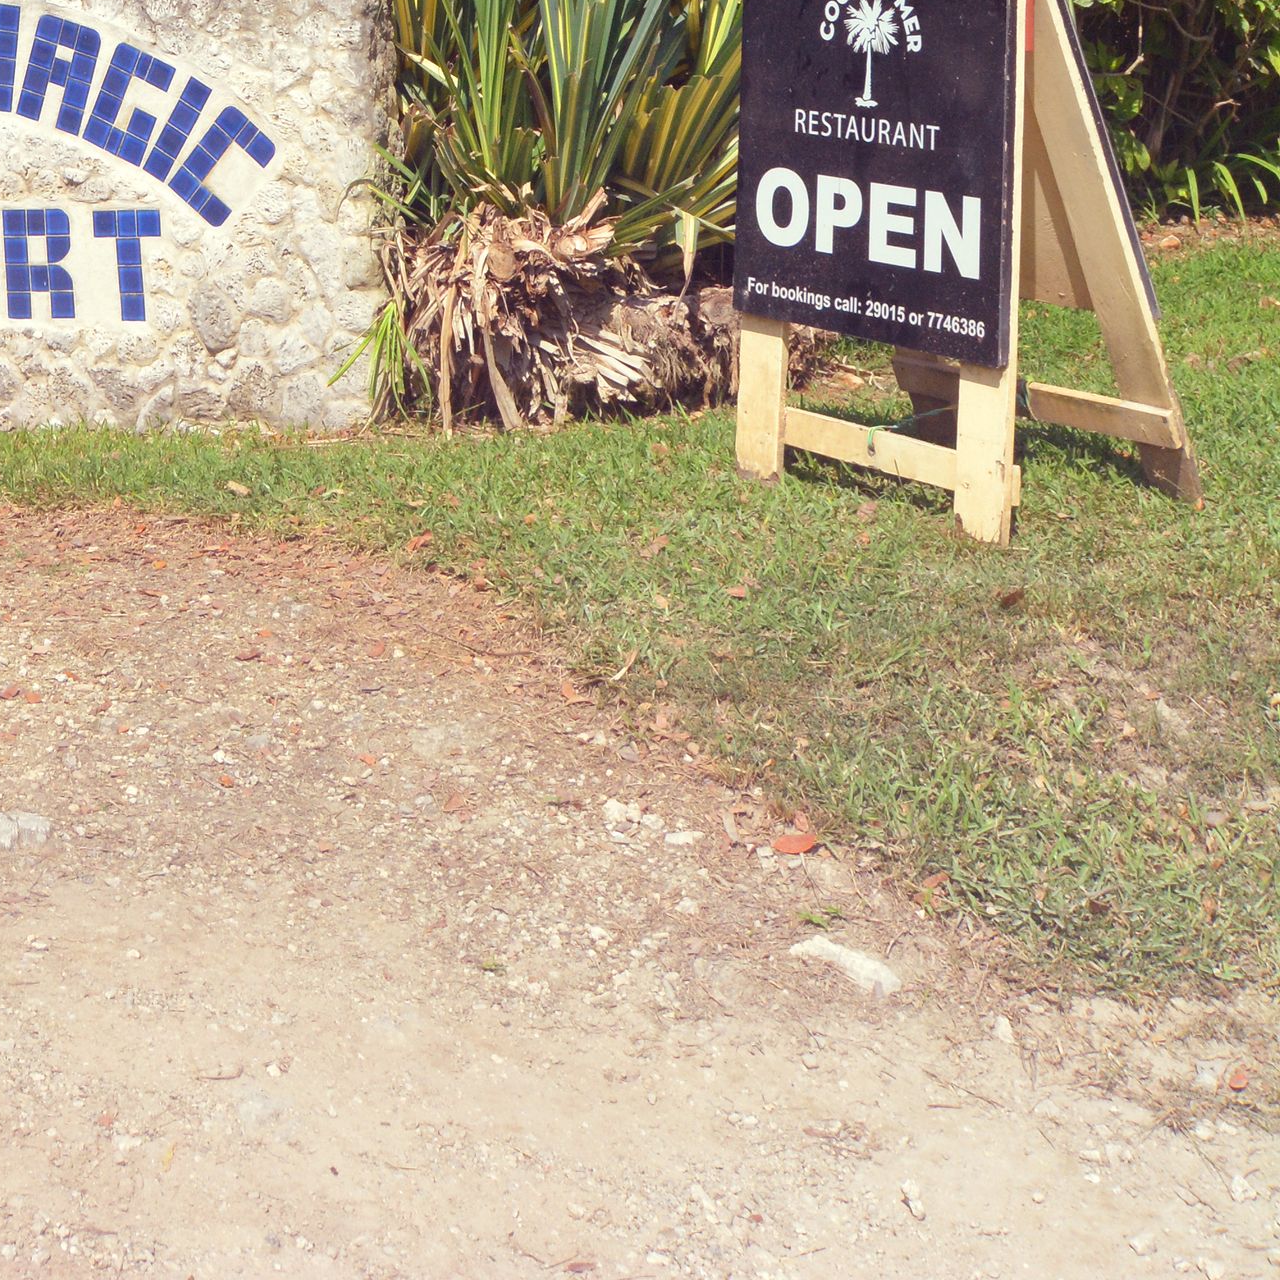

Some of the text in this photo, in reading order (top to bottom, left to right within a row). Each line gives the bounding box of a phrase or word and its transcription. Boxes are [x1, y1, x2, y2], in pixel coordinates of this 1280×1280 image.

[794, 109, 940, 151] RESTAURANT
[755, 167, 981, 280] OPEN
[747, 277, 986, 338] For bookings call: 29015 or 7746386
